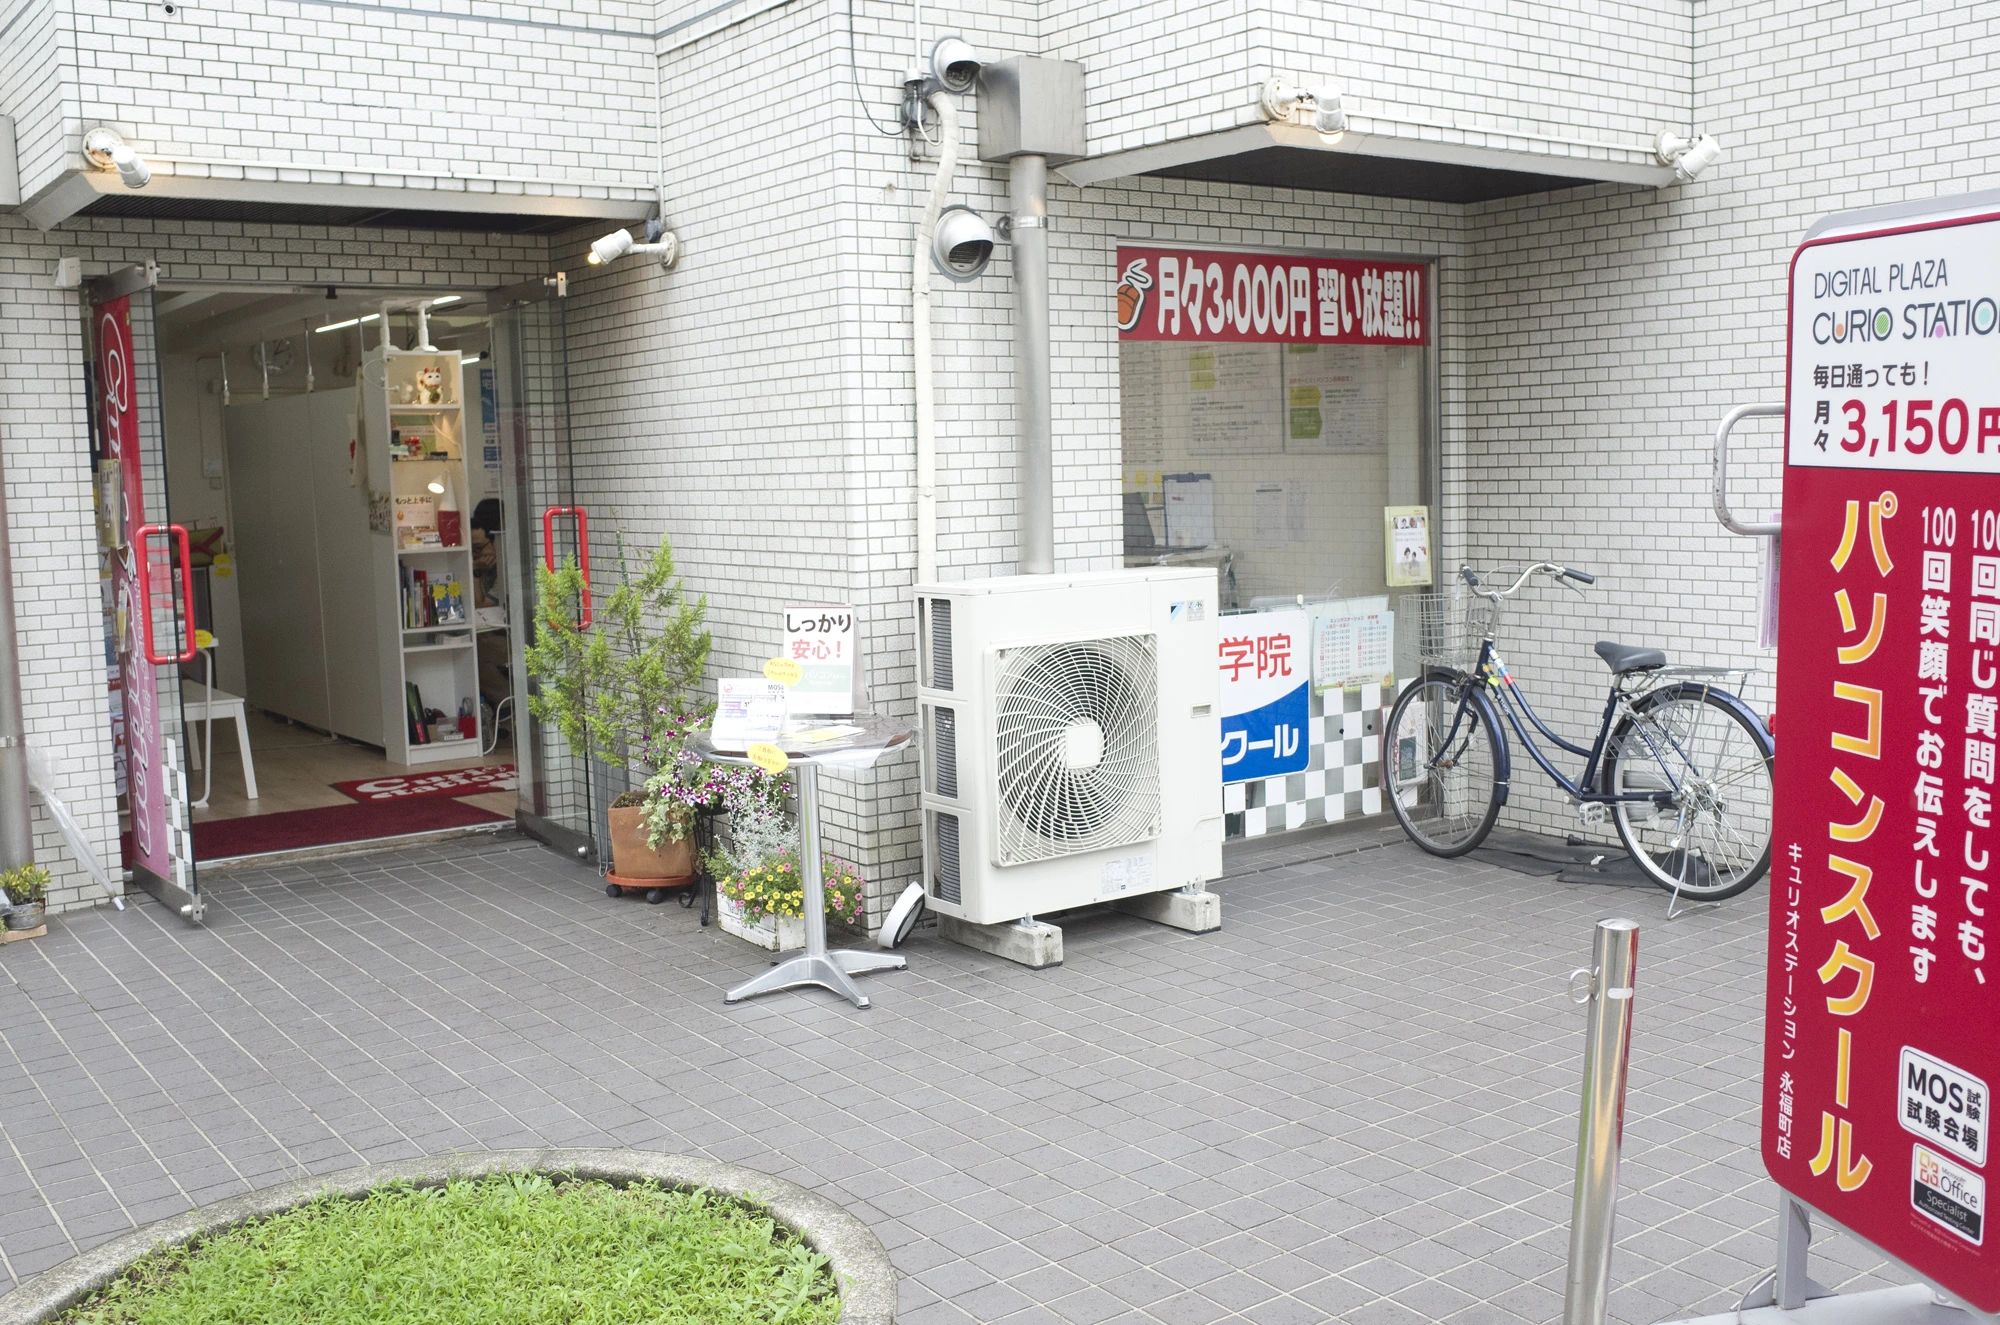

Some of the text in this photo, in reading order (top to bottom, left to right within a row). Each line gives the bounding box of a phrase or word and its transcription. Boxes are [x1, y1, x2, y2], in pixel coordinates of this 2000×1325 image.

[1157, 256, 1420, 339] 月々3,000円 習い放題!!
[1814, 258, 1948, 299] DIGITAL PLAZA
[1812, 297, 2000, 345] CURIO STATIO
[1813, 361, 1929, 389] 毎日通っても!
[1814, 400, 1830, 452] 月々
[786, 613, 851, 633] しっかり
[791, 639, 842, 660] 安心!
[1219, 633, 1292, 682] 学院
[1220, 723, 1299, 766] クール
[1909, 506, 1956, 984] 100回笑顔でお伝えします
[1808, 490, 1898, 1193] パソコンスクール
[1776, 842, 1803, 1160] キュリオステーション 永福町店
[1907, 1062, 1963, 1114] MOS
[1906, 1097, 1978, 1152] 試験会場
[1926, 1190, 1968, 1222] Specialist
[1940, 1175, 1978, 1208] Office
